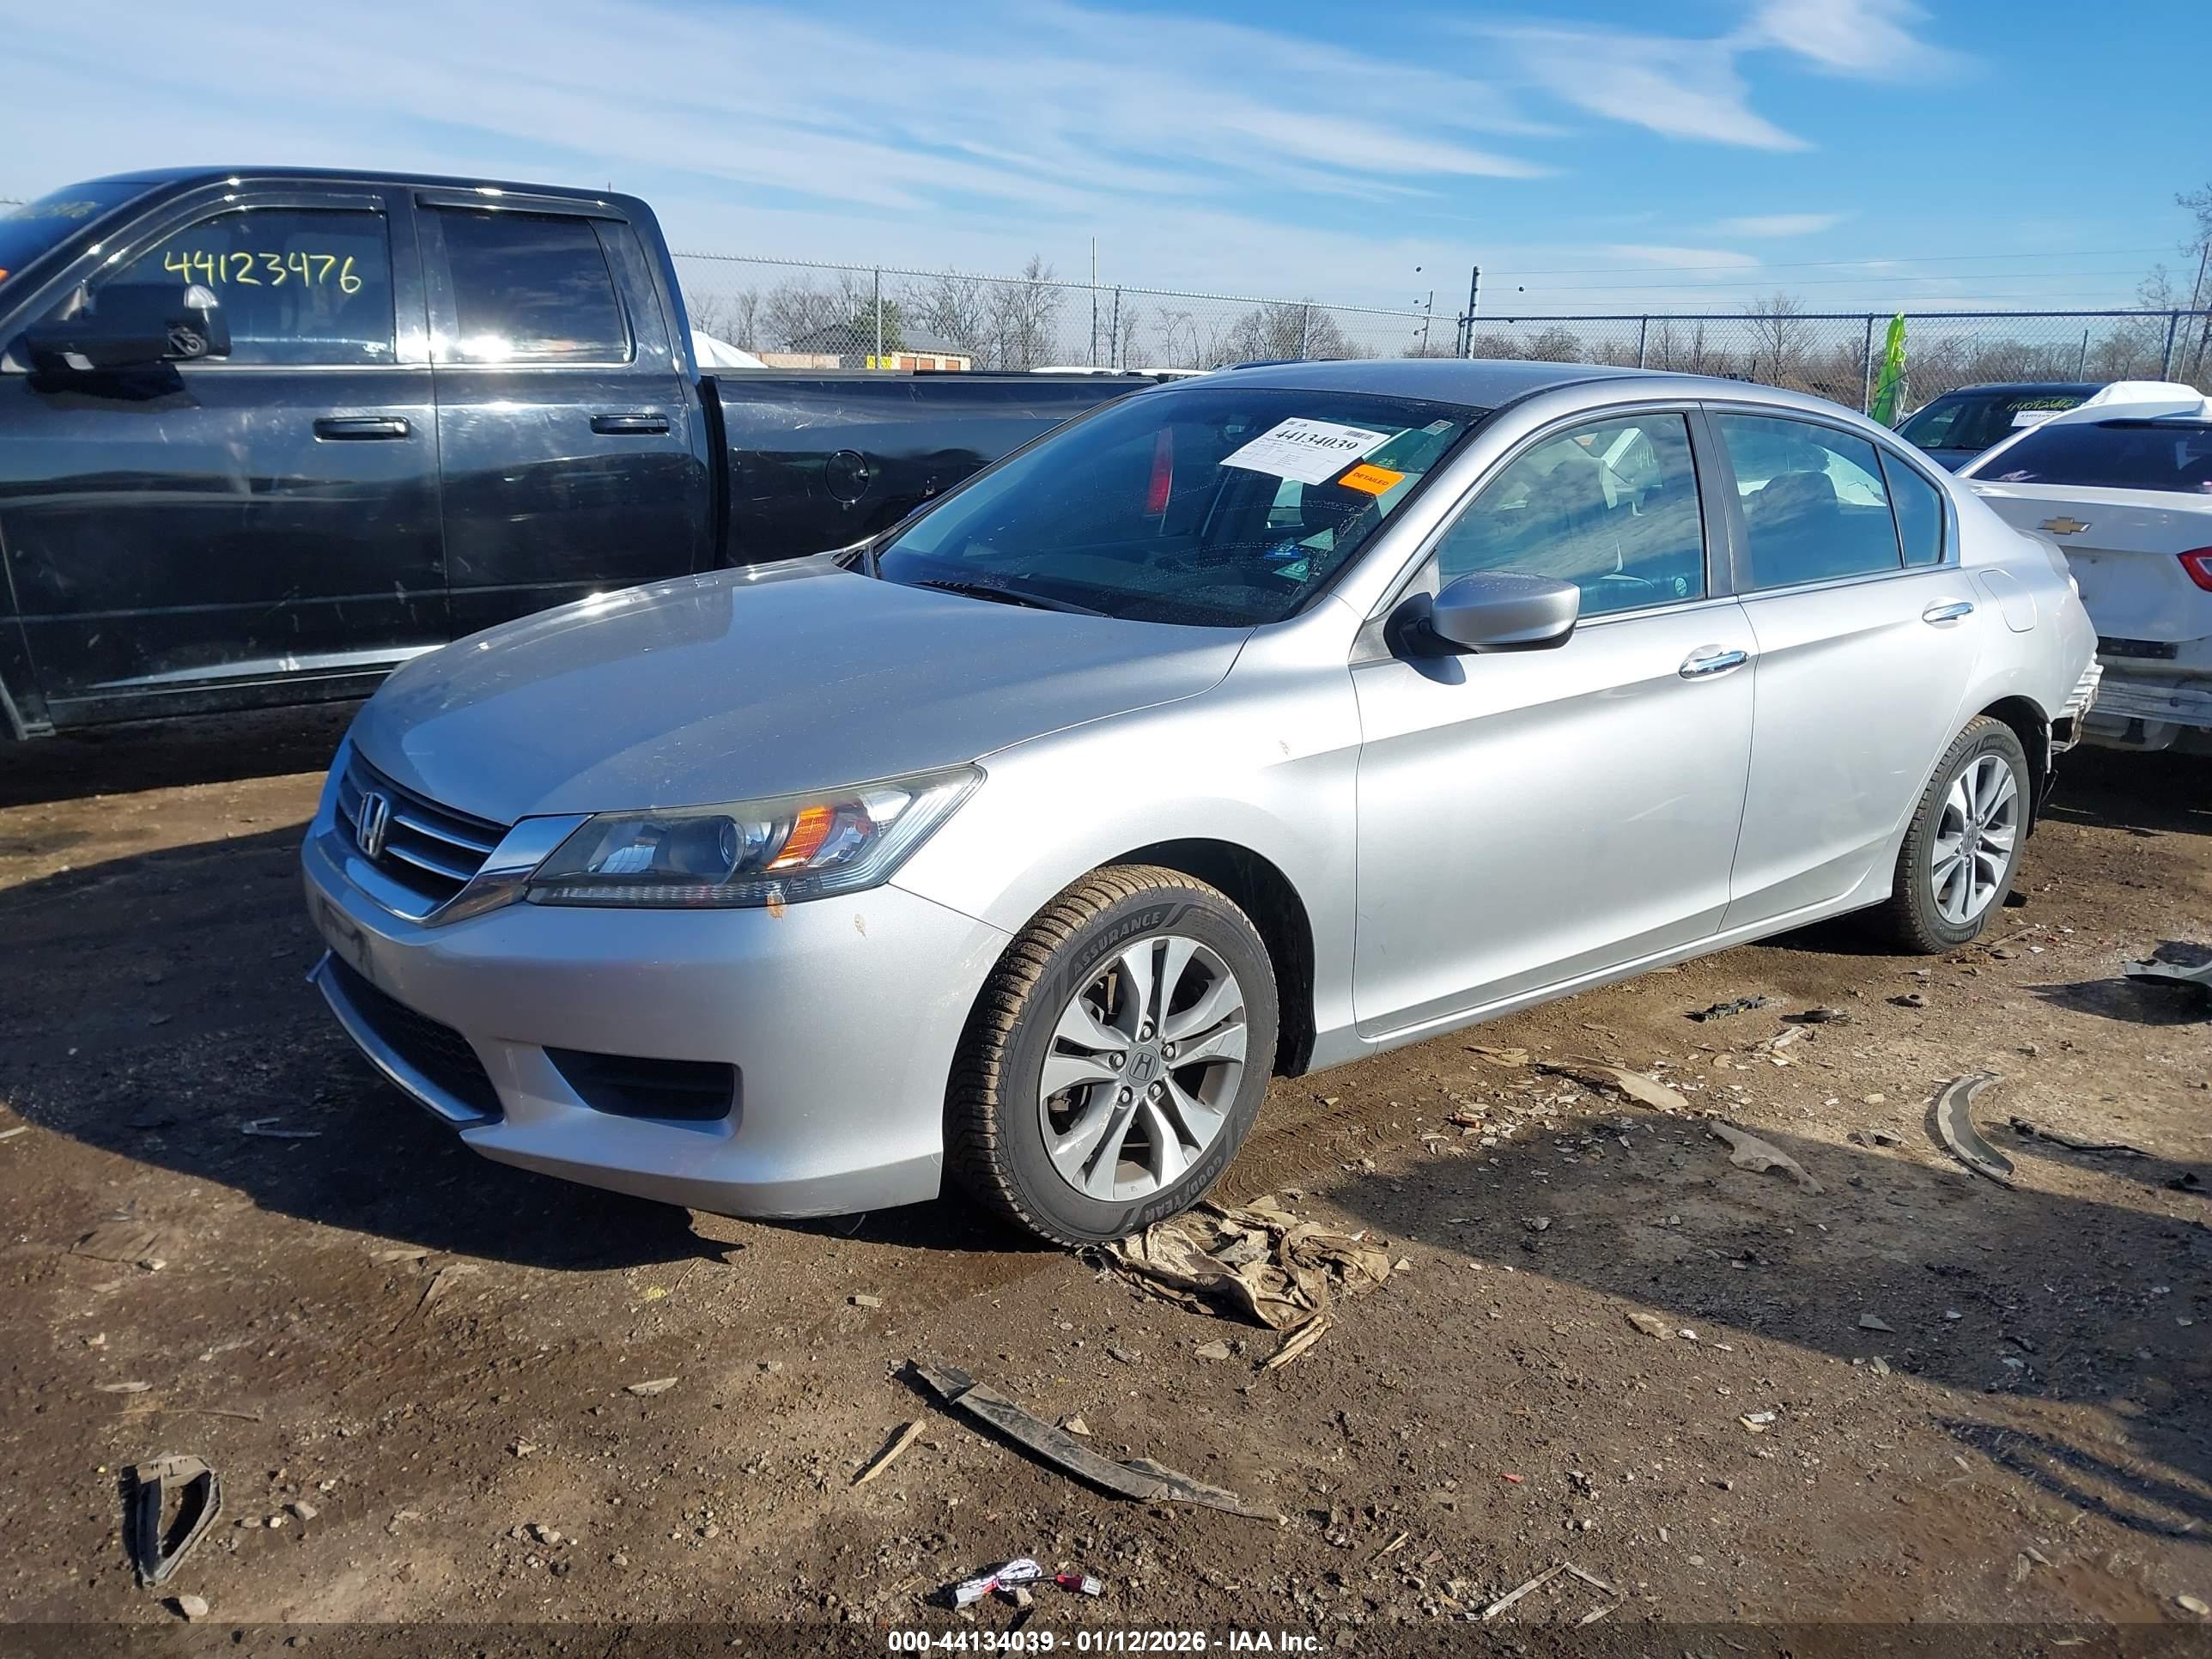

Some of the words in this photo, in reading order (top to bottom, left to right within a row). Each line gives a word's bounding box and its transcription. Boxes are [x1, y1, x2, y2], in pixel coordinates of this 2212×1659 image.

[163, 249, 363, 294] 44123476
[1274, 429, 1359, 451] 44134039
[1352, 471, 1389, 486] DETAILED
[1288, 562, 1307, 573] 19
[1073, 911, 1162, 977] ASSURANCE
[1145, 1155, 1223, 1223] GOODYEAR
